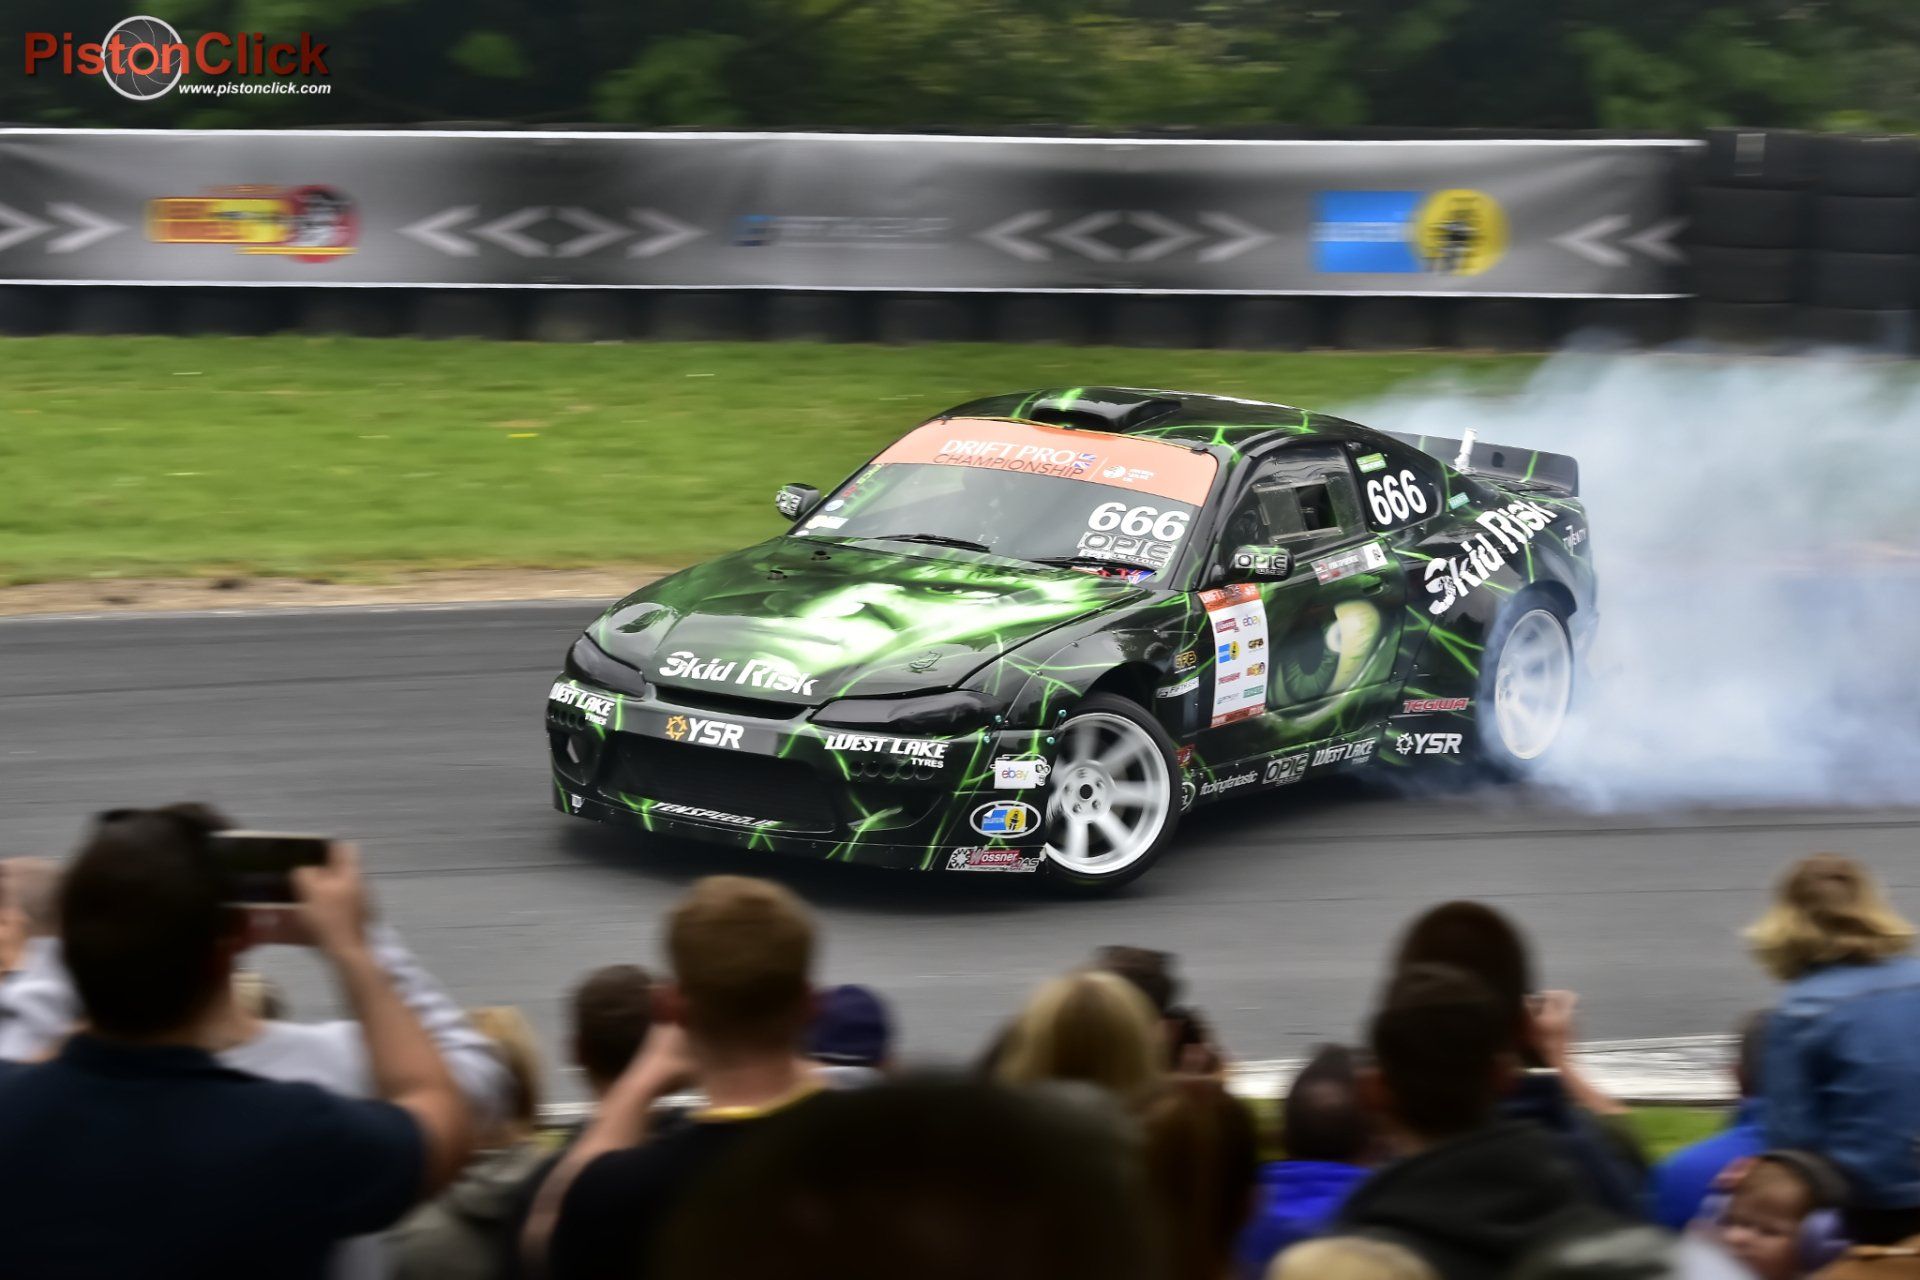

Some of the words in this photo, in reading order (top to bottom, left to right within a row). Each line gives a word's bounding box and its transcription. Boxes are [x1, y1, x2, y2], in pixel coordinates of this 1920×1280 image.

[933, 454, 1084, 478] CHAMPIONSHIP
[942, 440, 1015, 456] DRIFT
[1015, 446, 1073, 466] PRO
[1366, 469, 1427, 525] 666
[1088, 502, 1190, 541] 666
[1077, 532, 1176, 561] OPIE
[1424, 532, 1505, 615] Skid
[1475, 500, 1558, 555] Risk
[1235, 553, 1288, 570] OPIE
[659, 652, 737, 682] Skid
[735, 659, 819, 696] Risk
[549, 682, 581, 705] WEST
[575, 692, 615, 717] LAKE
[687, 717, 744, 748] YSR
[824, 734, 888, 752] WEST
[890, 738, 949, 759] LAKE
[1414, 733, 1462, 754] YSR
[910, 757, 944, 768] TYRES
[1311, 747, 1346, 767] WEST
[1343, 739, 1376, 760] LAKE
[1001, 767, 1030, 781] ebay
[1263, 753, 1309, 784] OPIE
